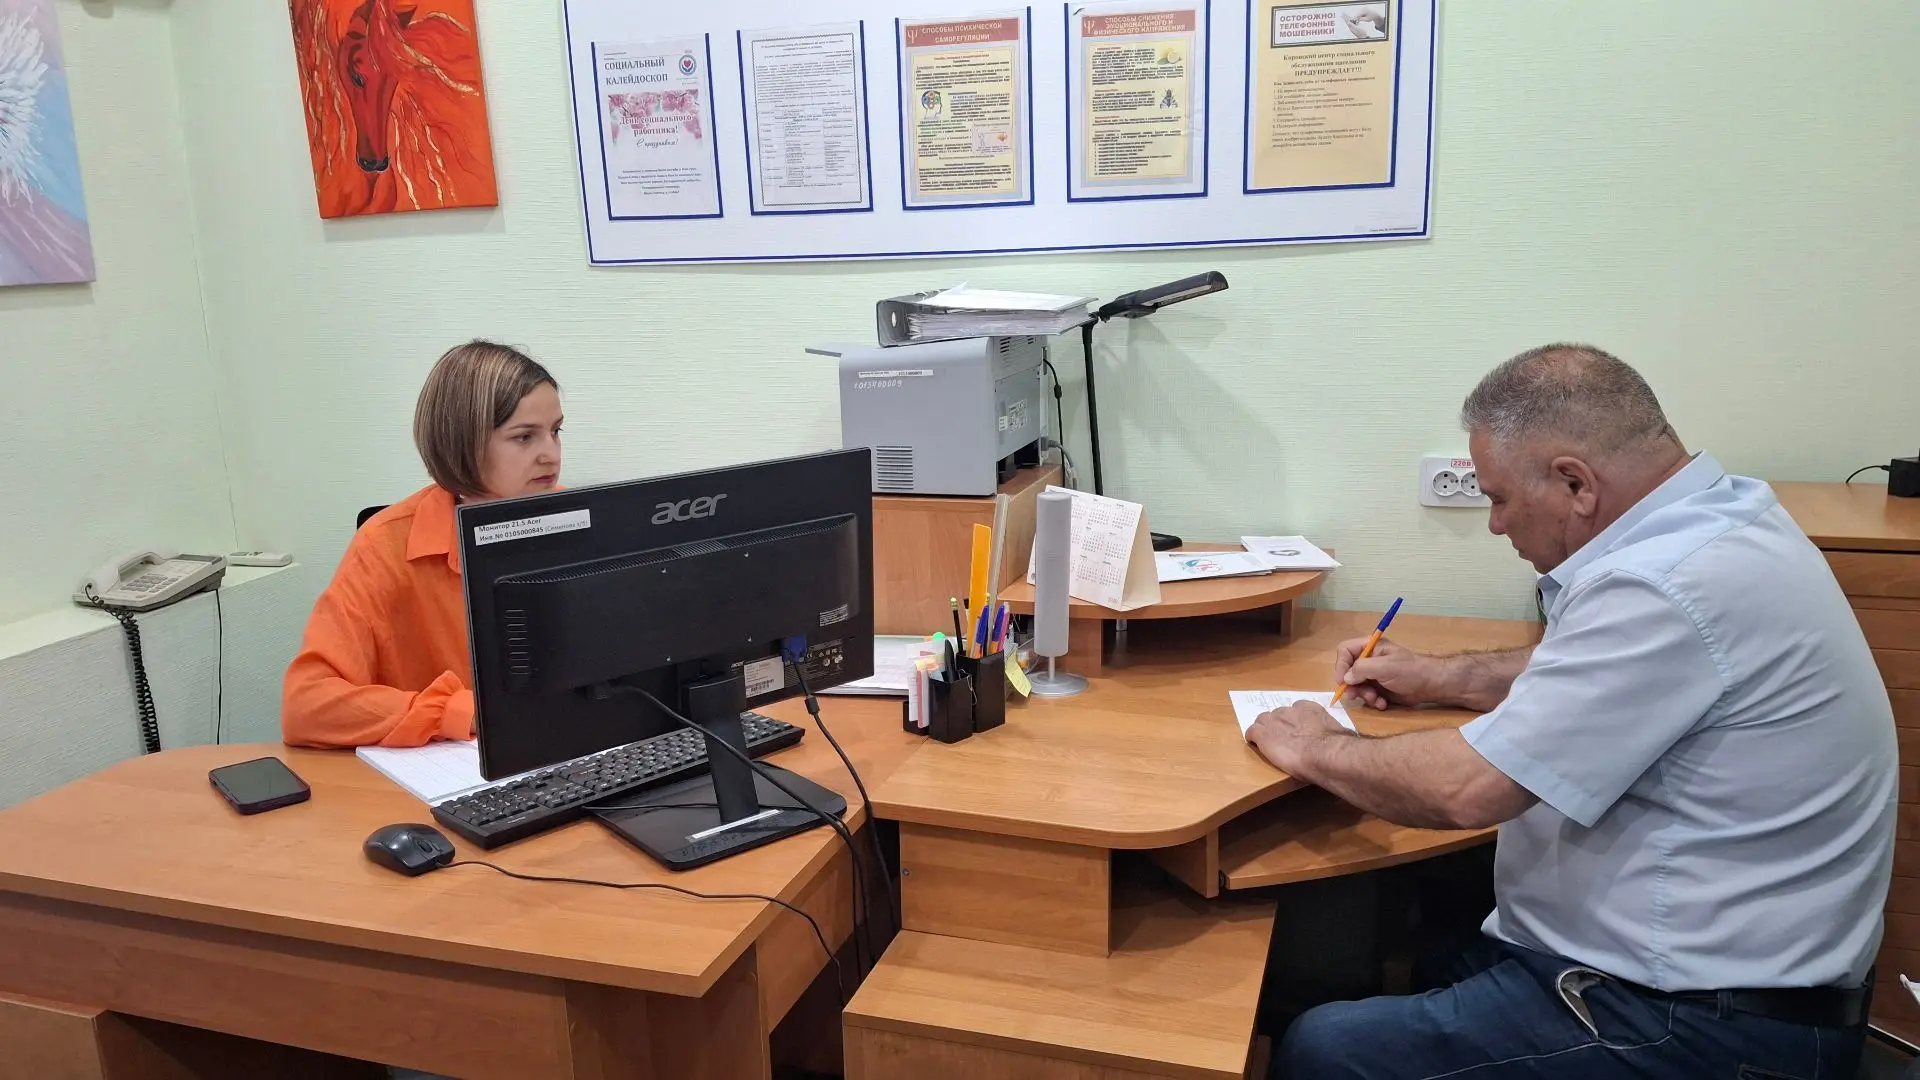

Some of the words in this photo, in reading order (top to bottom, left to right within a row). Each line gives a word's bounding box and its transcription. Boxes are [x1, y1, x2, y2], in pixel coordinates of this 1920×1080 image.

[1104, 16, 1137, 24] СПОСОБЫ
[1137, 13, 1175, 21] СНИЖЕНИЯ
[1280, 12, 1336, 22] ОСТОРОЖНО!
[921, 27, 954, 35] СПОСОБЫ
[955, 22, 1003, 32] ПСИХИЧЕСКОЙ
[1093, 27, 1140, 35] ФИЗИЧЕСКОГО
[1141, 24, 1186, 33] НАПРЯЖЕНИЯ
[1105, 20, 1167, 29] ЭМОЦИОНАЛЬНОГО
[1280, 20, 1336, 30] ТЕЛЕФОННЫЕ
[1279, 28, 1335, 38] МОШЕННИКИ
[934, 34, 990, 44] САМОРЕГУЛЯЦИИ
[604, 57, 665, 71] СОЦИАЛЬНЫЙ
[605, 73, 668, 86] КАЛЕЙДОСКОП
[620, 116, 640, 125] День
[640, 115, 692, 125] социального
[633, 125, 678, 137] работника!
[651, 493, 728, 525] acer
[478, 522, 510, 533] Монитор
[511, 520, 526, 528] 21.5
[527, 518, 542, 526] Acer
[504, 527, 544, 538] 0105000845
